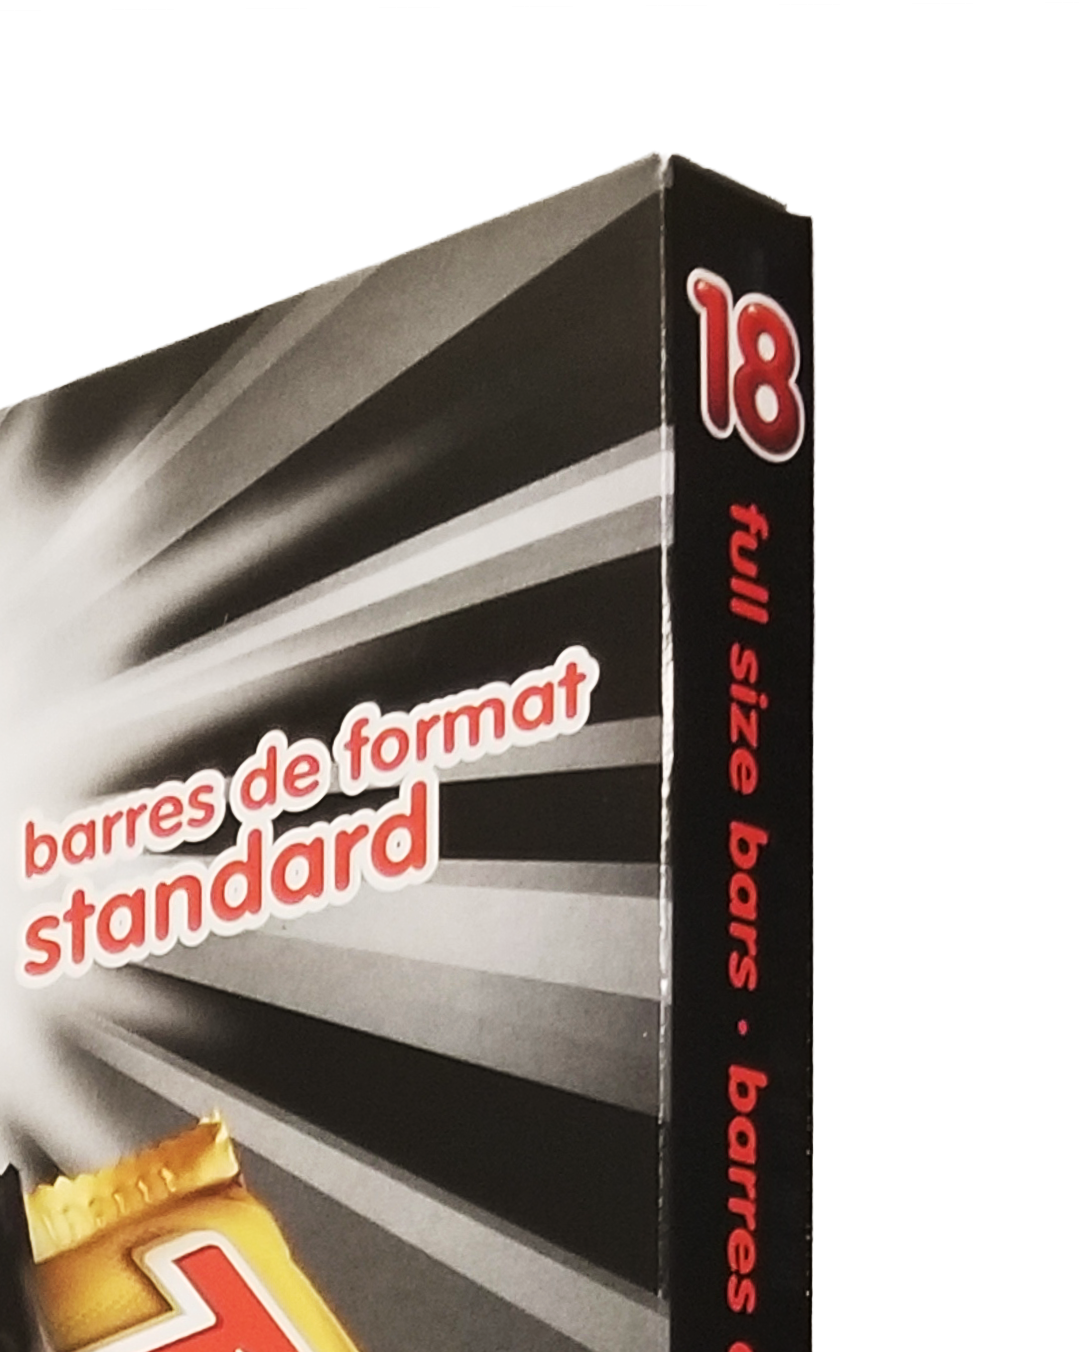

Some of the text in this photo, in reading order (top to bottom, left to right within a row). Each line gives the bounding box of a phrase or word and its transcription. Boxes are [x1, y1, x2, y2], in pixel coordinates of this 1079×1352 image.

[693, 278, 799, 455] 18
[729, 503, 769, 625] full
[25, 660, 587, 878] barres de format
[729, 642, 768, 796] size
[25, 786, 428, 974] standard
[728, 821, 769, 992] bars
[727, 1064, 768, 1315] barres
